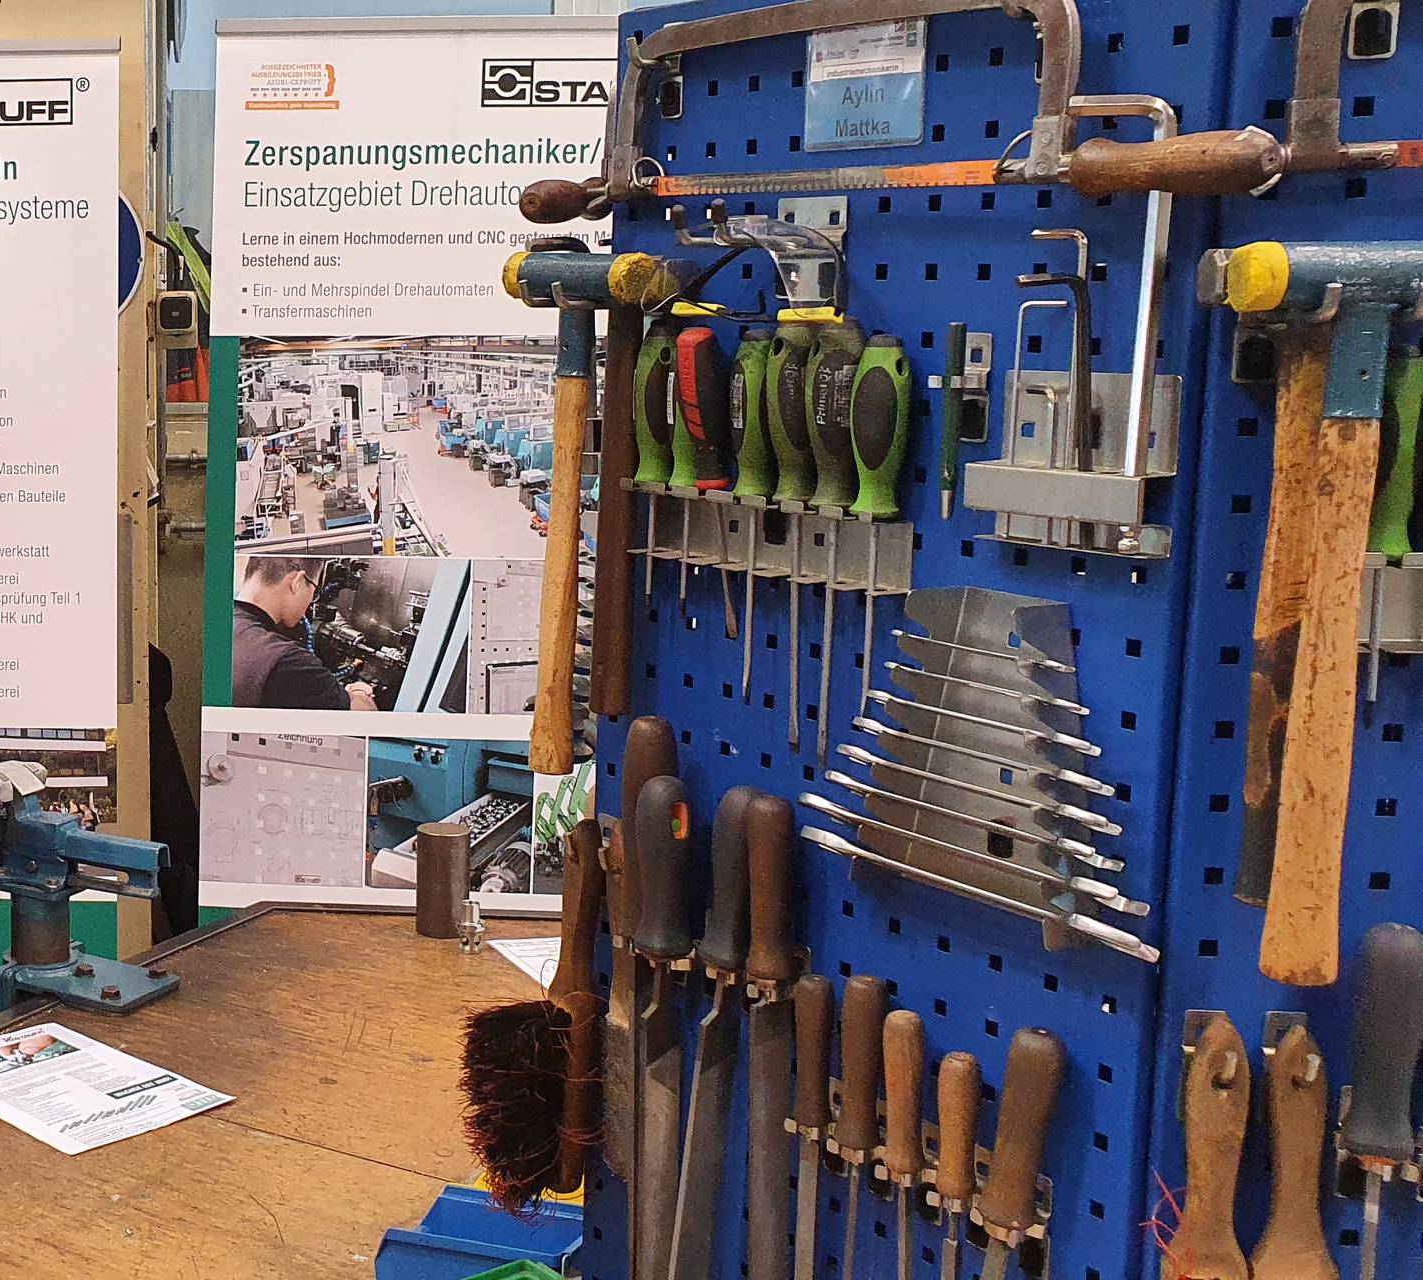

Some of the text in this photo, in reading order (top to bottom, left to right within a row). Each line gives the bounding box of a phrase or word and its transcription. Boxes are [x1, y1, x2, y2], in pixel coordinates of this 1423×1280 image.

[534, 80, 609, 103] STA
[842, 84, 885, 109] Aylin
[835, 118, 891, 138] Mattka
[244, 139, 601, 170] Zerspanungsmechaniker/
[245, 179, 521, 212] Einsatzgebiet Drehauto
[243, 232, 278, 245] Lerne
[284, 232, 294, 245] in
[300, 232, 338, 245] einem
[344, 232, 443, 244] Hochmodernen
[449, 231, 472, 244] und
[478, 231, 505, 244] CNC
[242, 254, 340, 267] bestehend aus:
[254, 283, 493, 299] Ein- und Mehrspindel Drehautomaten
[252, 304, 371, 318] Transfermaschinen
[19, 490, 65, 502] Bauteile
[51, 592, 69, 604] Teil
[76, 592, 80, 604] 1
[22, 611, 42, 623] und
